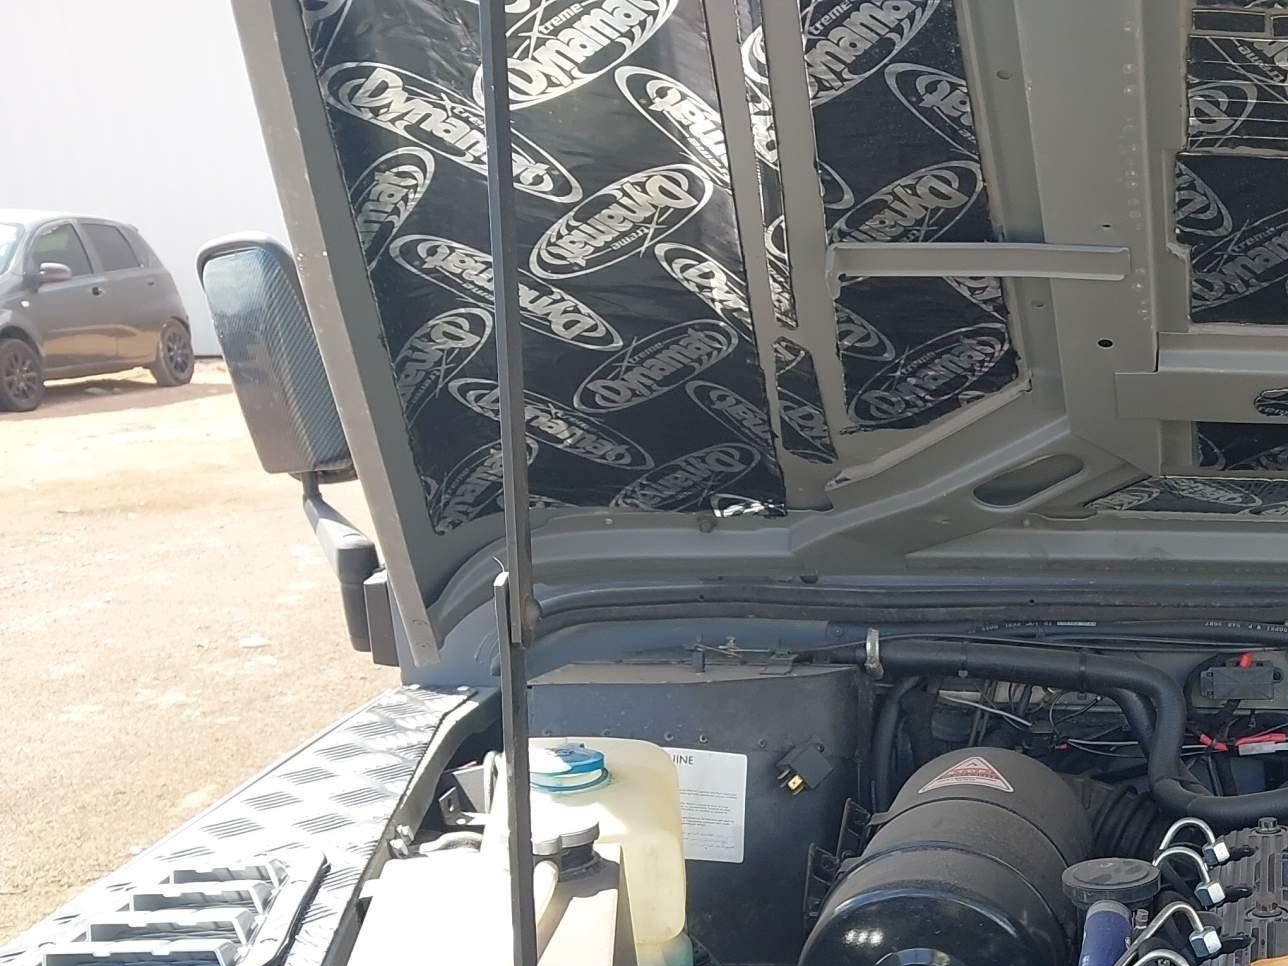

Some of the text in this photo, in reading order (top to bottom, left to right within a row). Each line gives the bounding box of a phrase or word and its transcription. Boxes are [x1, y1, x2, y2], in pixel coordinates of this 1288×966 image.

[549, 175, 699, 266] Dynamat
[610, 206, 667, 258] Xtreme
[587, 328, 716, 402] Dynamat
[869, 336, 990, 420] Dynamat
